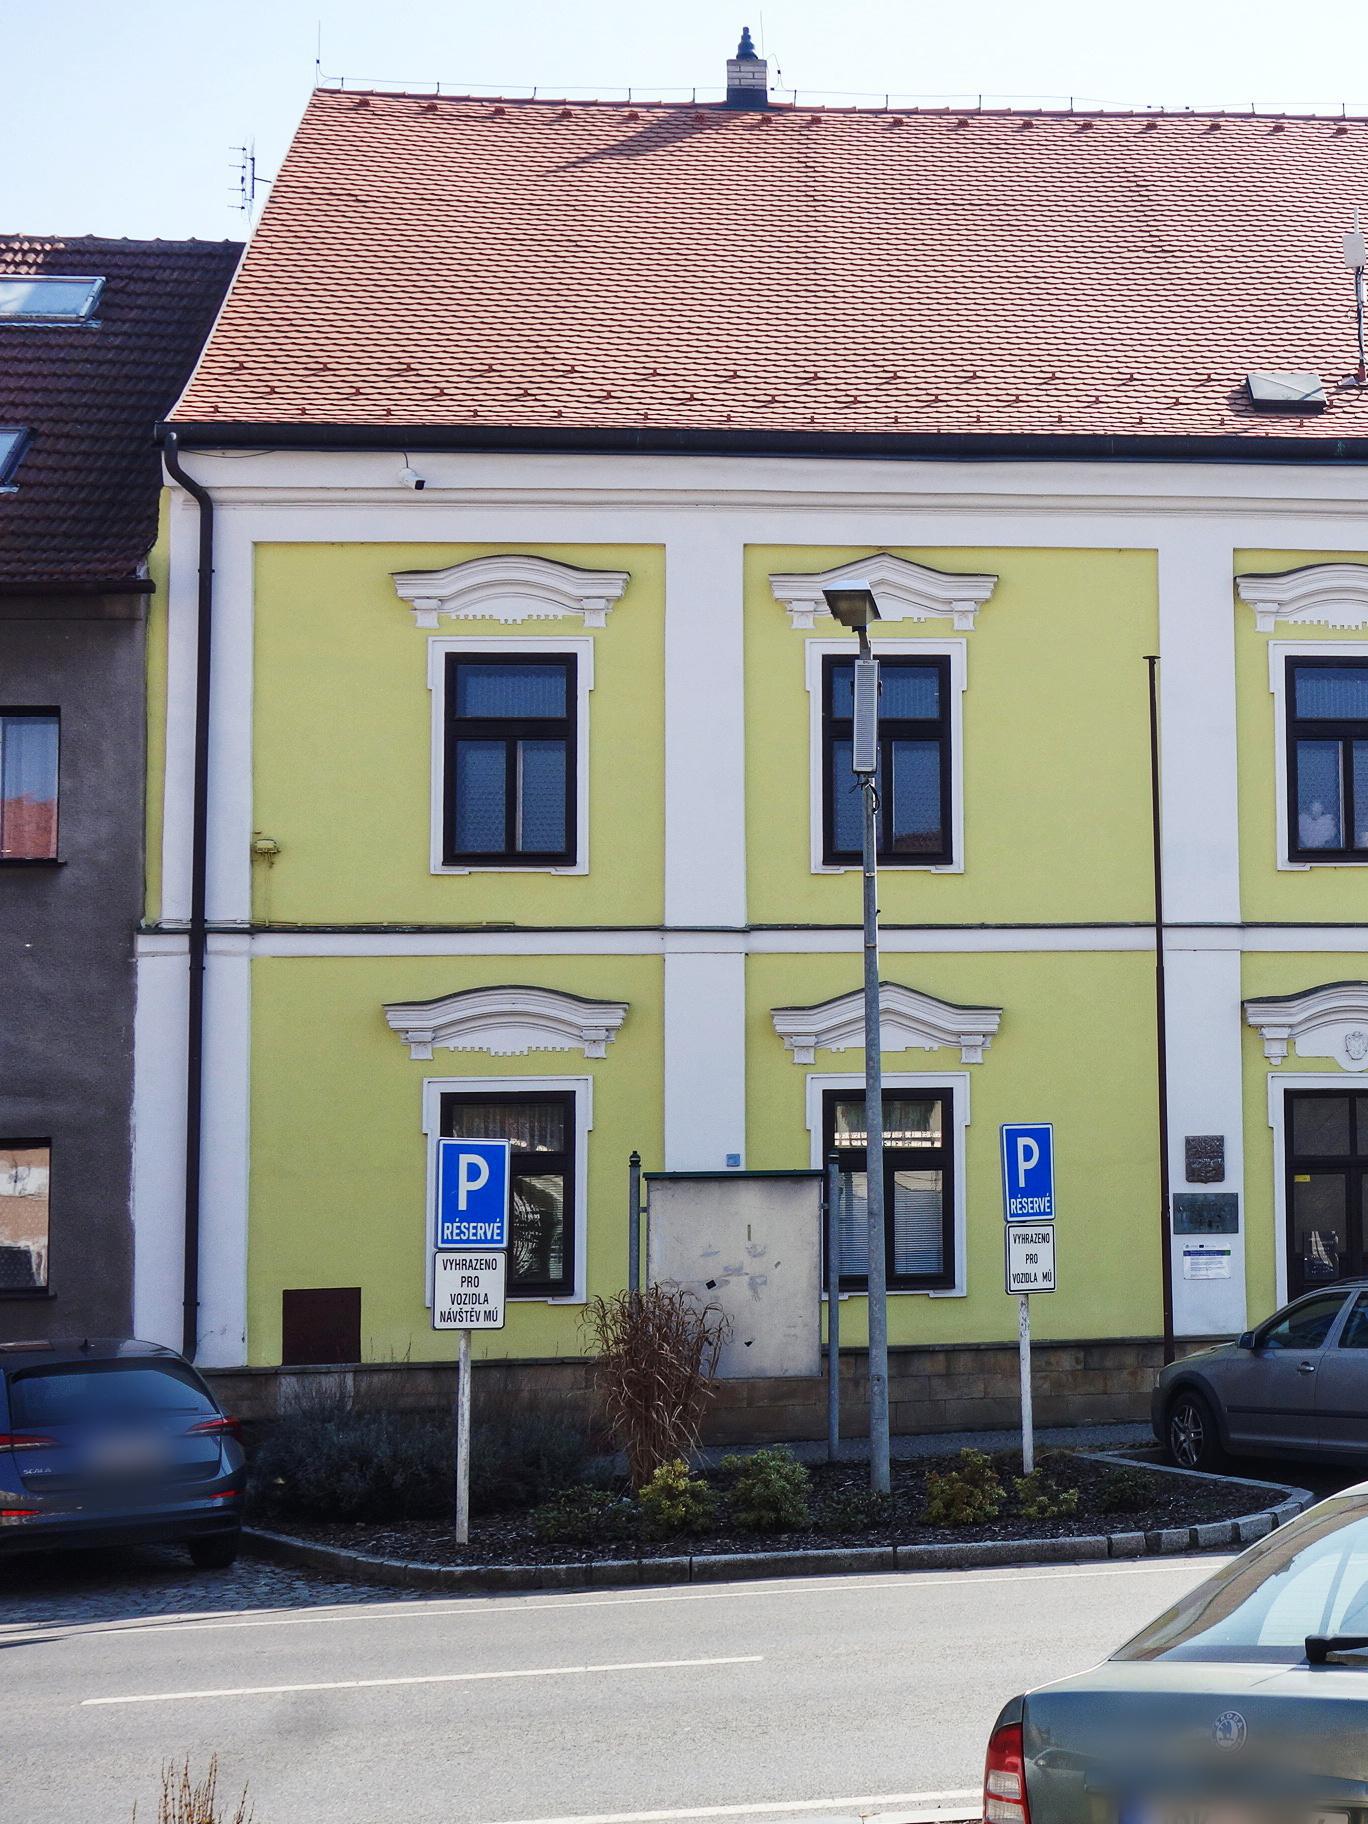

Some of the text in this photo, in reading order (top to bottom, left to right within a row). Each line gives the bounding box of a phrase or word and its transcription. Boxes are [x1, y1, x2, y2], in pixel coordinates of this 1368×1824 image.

[1016, 1136, 1040, 1188] P
[457, 1153, 490, 1211] P
[1010, 1193, 1051, 1215] RÉSERVÉ
[443, 1217, 502, 1241] RÉSERVÉ
[1012, 1232, 1051, 1245] VYHRAZENO
[442, 1258, 498, 1271] VYHRAZENO
[1025, 1252, 1039, 1265] PRO
[460, 1275, 480, 1288] PRO
[1011, 1268, 1053, 1285] VOZIDLA MÚ
[449, 1292, 489, 1306] VOZIDLA
[439, 1306, 499, 1323] NÁVŠTĚV MÚ
